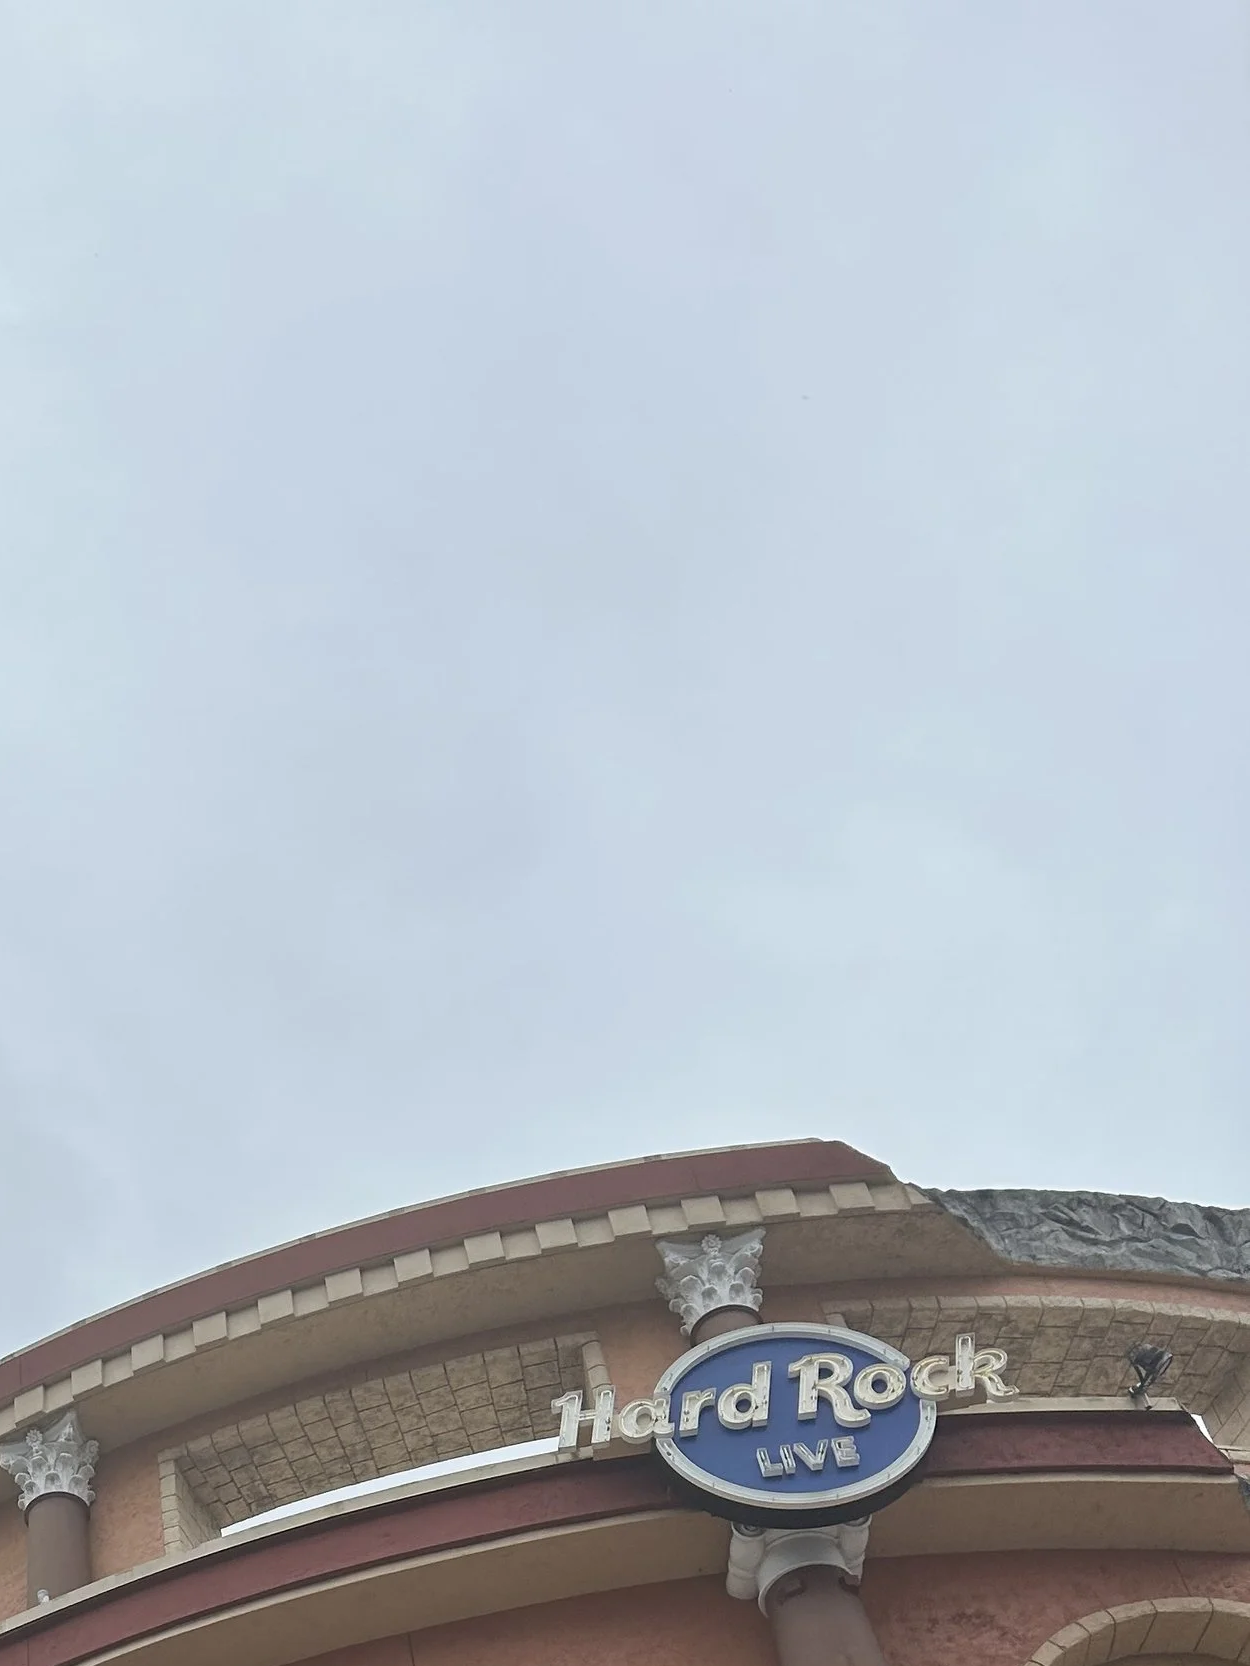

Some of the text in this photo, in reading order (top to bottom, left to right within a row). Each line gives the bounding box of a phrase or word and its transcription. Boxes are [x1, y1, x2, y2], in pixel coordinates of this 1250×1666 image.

[550, 1333, 1020, 1451] Hard Rock
[756, 1435, 861, 1478] LIVE
